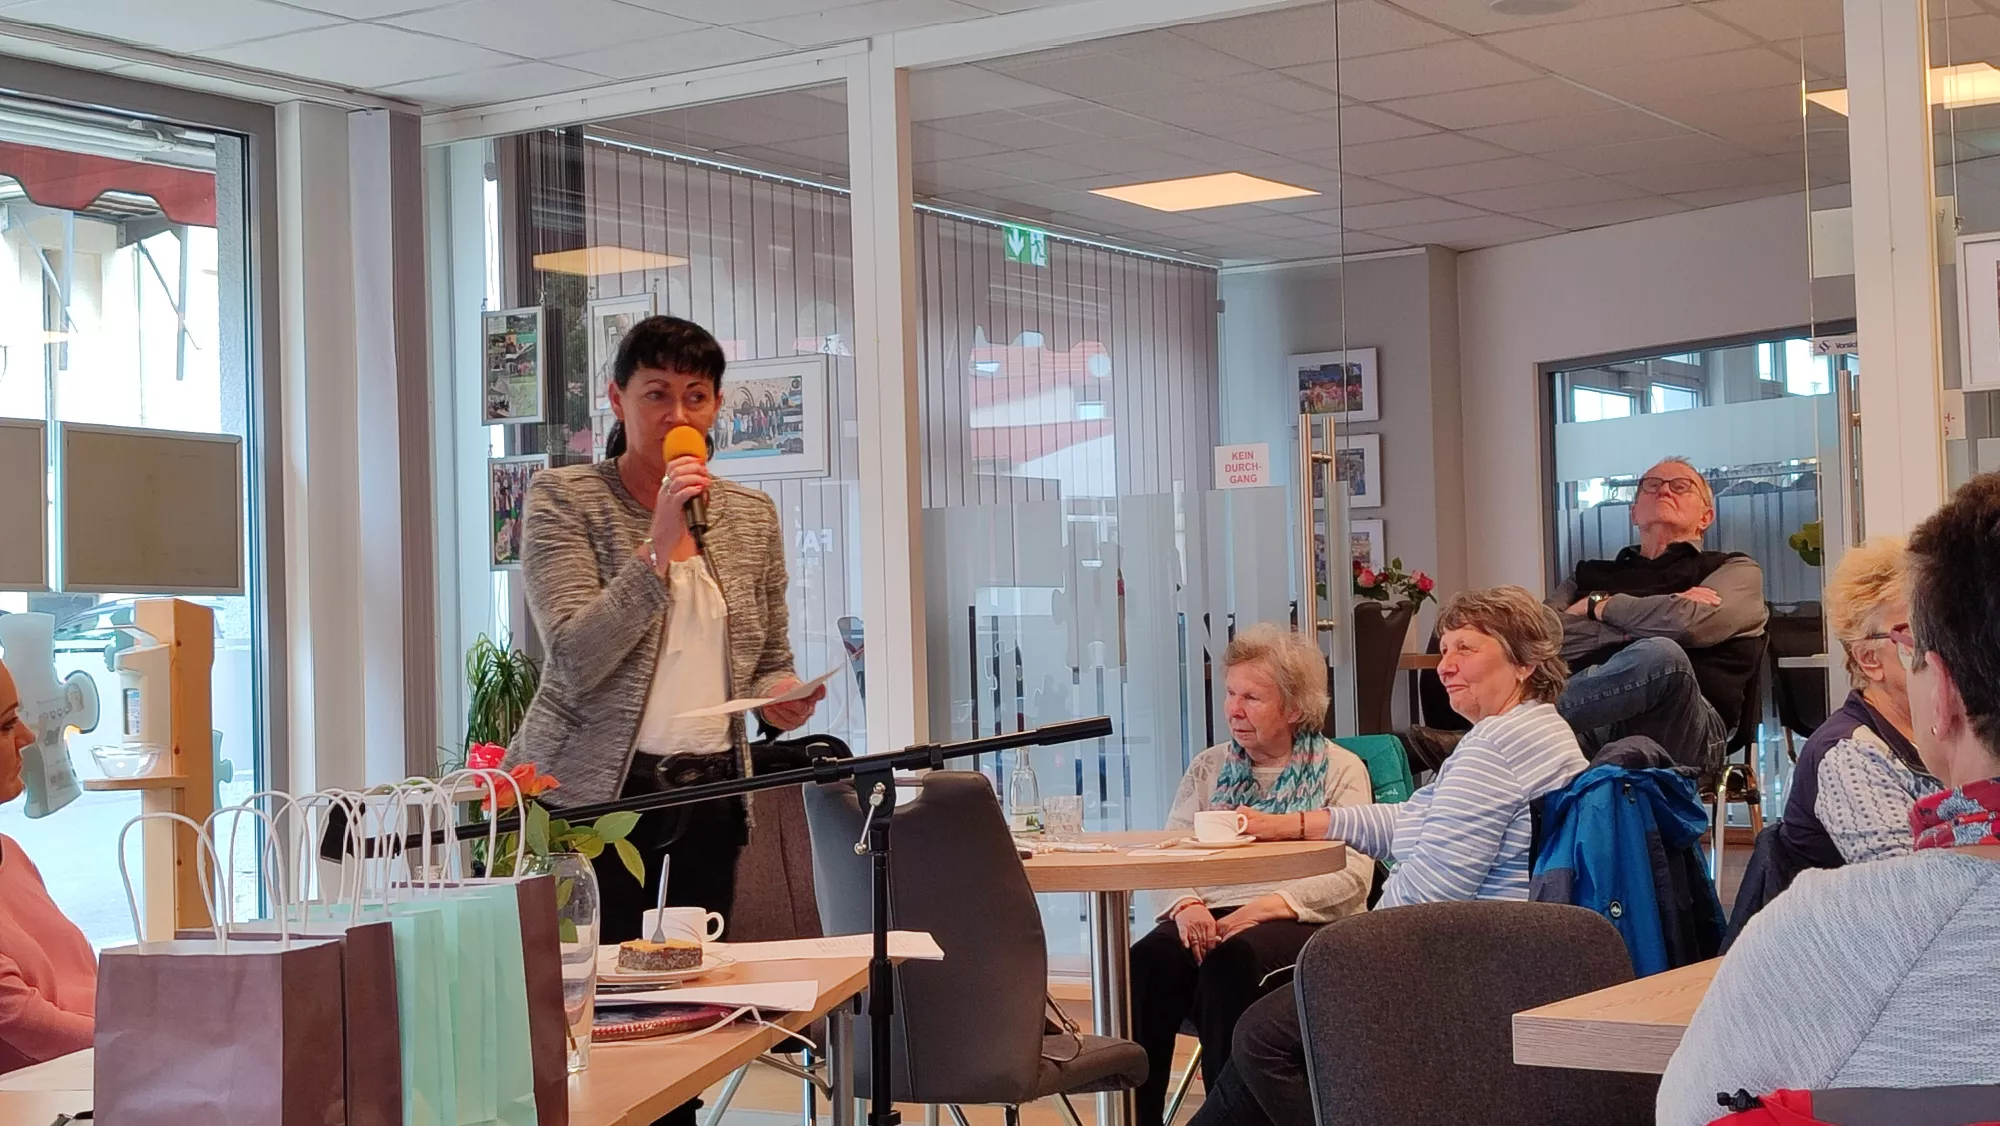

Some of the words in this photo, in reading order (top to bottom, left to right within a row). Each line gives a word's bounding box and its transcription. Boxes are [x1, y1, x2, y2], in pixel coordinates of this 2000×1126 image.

[1835, 341, 1857, 349] Vorsic
[1232, 451, 1254, 461] KEIN
[1225, 462, 1262, 473] DURCH-
[1229, 474, 1257, 484] GANG
